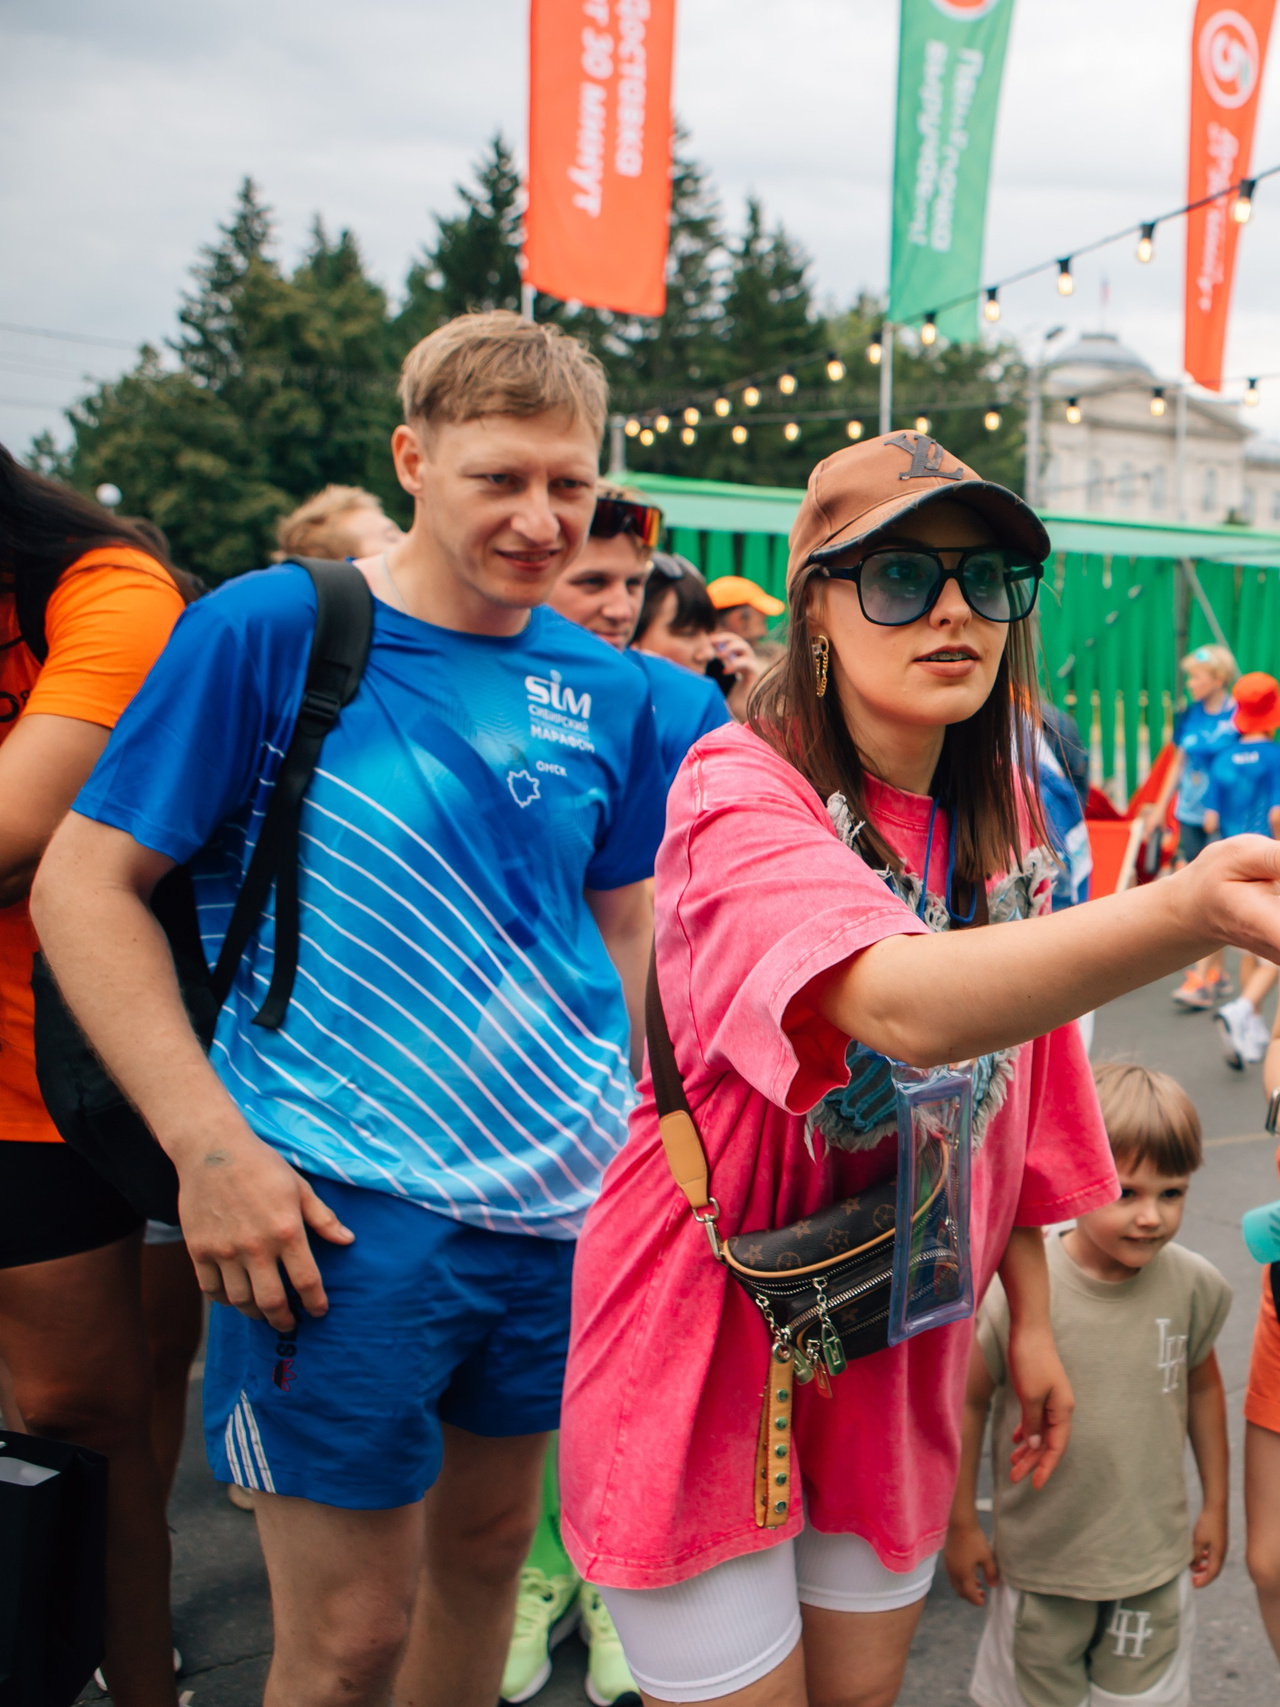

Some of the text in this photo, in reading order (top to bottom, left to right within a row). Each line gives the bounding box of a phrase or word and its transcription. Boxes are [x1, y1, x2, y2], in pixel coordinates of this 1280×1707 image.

[581, 26, 615, 80] 30
[567, 81, 607, 219] минут
[528, 703, 589, 734] СИБИРСКИЙ
[530, 724, 595, 753] МАРАФОН
[536, 760, 568, 777] ОМСК
